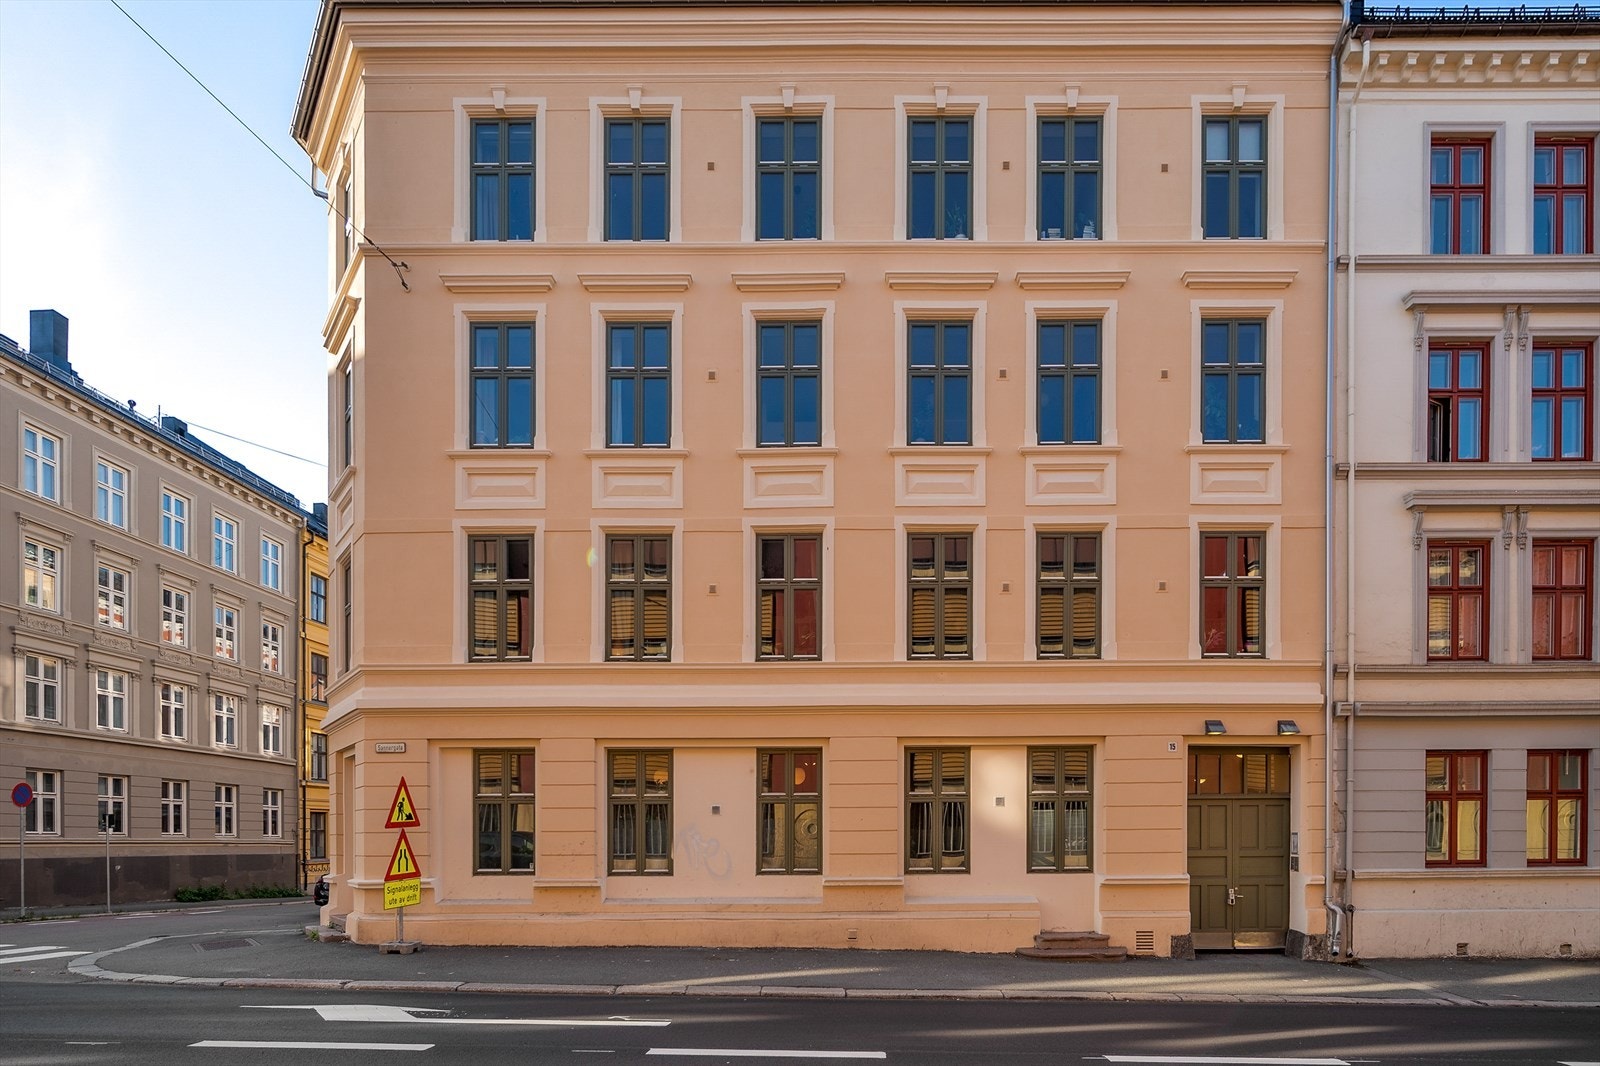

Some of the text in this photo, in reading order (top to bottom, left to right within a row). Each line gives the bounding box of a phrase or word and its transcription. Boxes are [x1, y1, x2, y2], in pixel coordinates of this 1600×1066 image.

[1169, 743, 1176, 751] 15
[386, 884, 418, 895] Signalanlegg
[406, 894, 418, 902] drift
